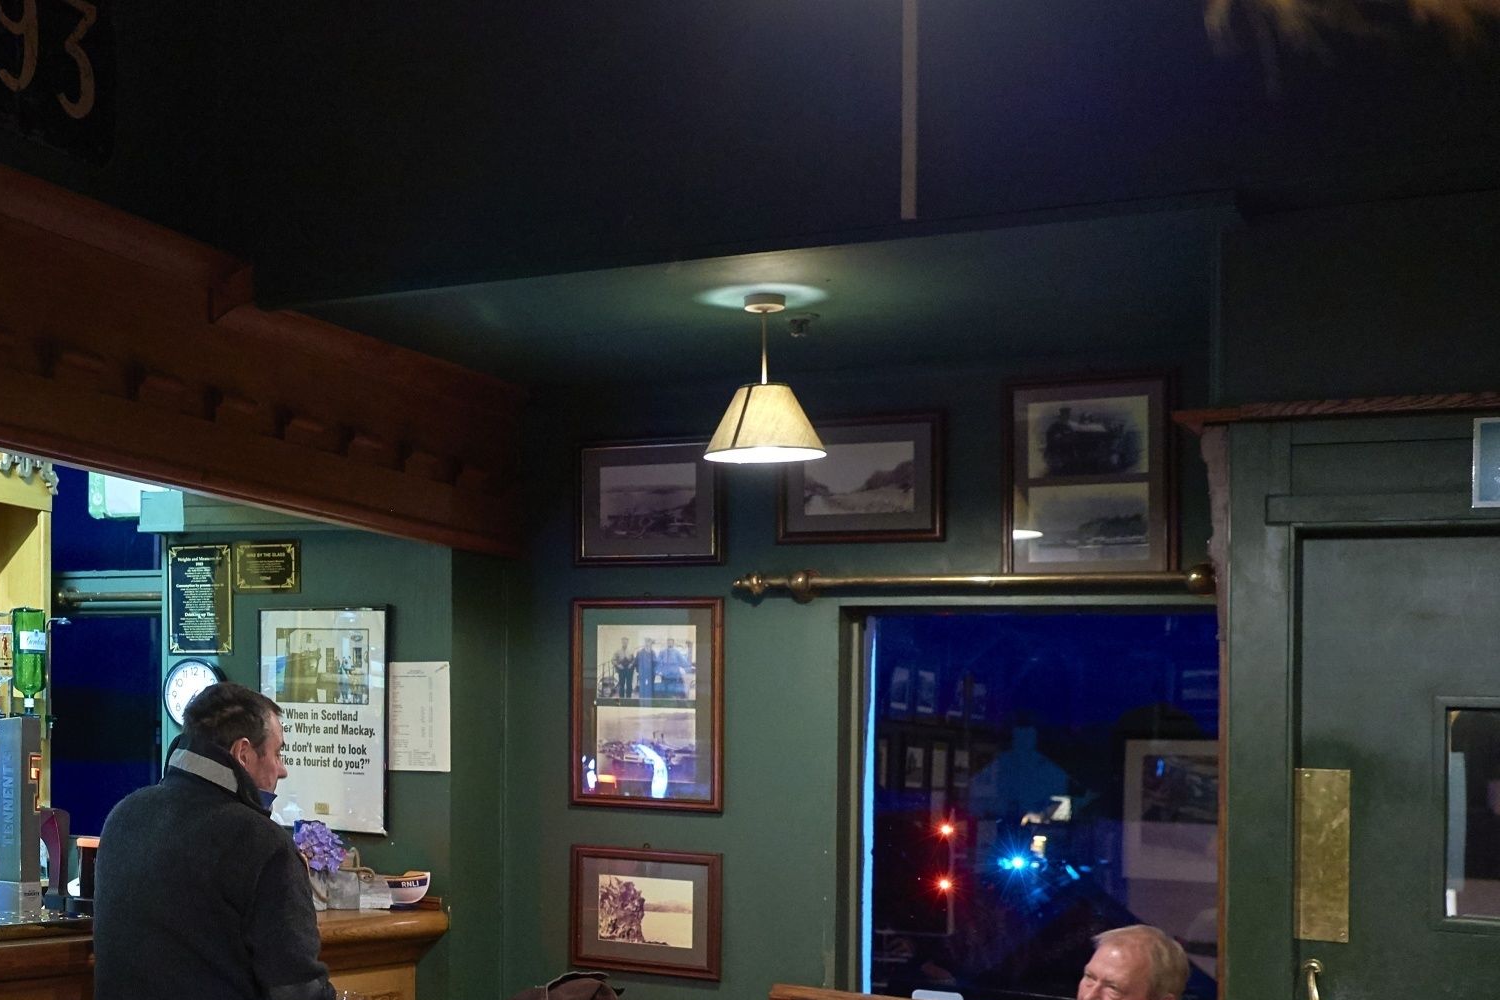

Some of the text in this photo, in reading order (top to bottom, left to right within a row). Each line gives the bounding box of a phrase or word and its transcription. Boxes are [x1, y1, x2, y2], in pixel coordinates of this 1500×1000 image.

[183, 669, 188, 679] 11
[191, 667, 198, 676] 12
[203, 670, 206, 678] 1
[175, 678, 183, 688] 10
[172, 690, 177, 698] 9
[176, 703, 181, 711] 8
[311, 709, 319, 720] in
[321, 709, 358, 721] Scotland
[295, 722, 321, 736] Whyte
[323, 723, 338, 735] and
[341, 724, 375, 738] Mackay.
[280, 741, 367, 755] ou don't want to look
[295, 757, 301, 766] a
[303, 756, 330, 768] tourist
[332, 758, 343, 769] do
[401, 880, 419, 888] RNLI
